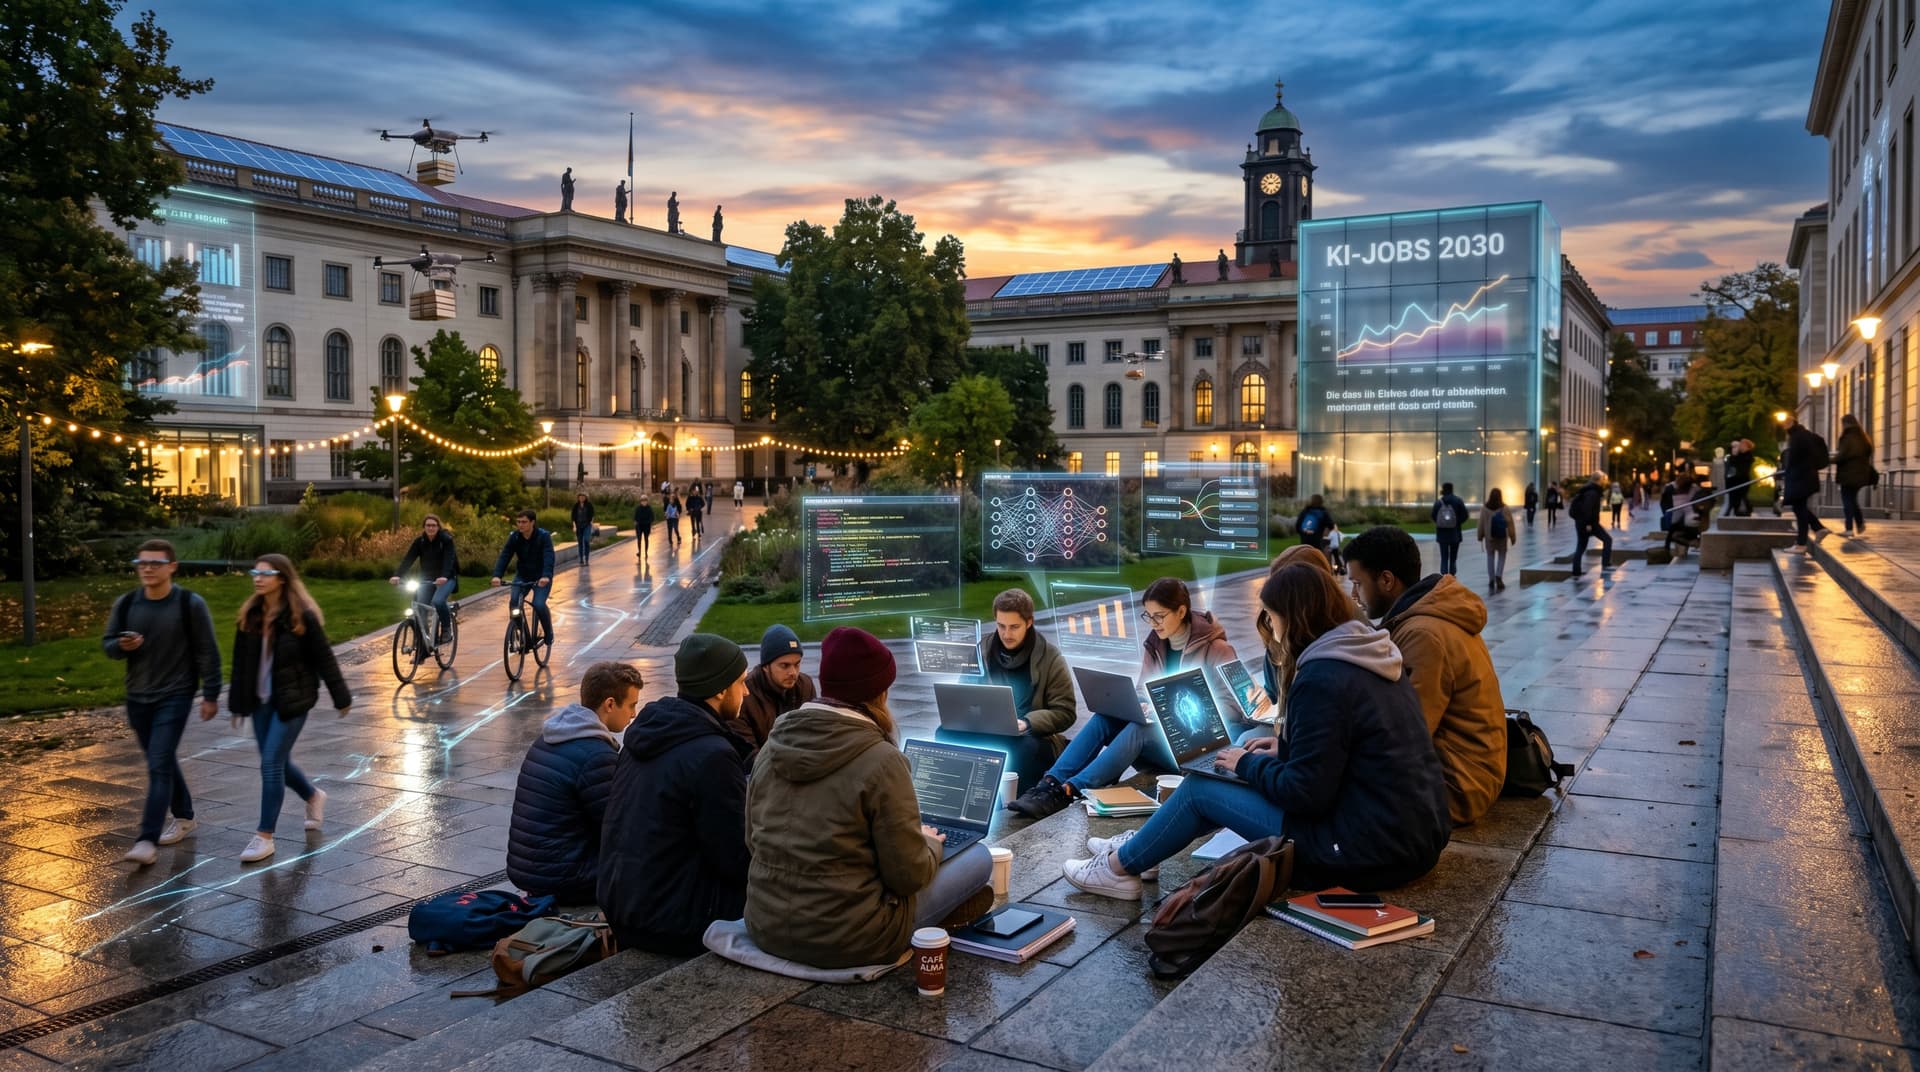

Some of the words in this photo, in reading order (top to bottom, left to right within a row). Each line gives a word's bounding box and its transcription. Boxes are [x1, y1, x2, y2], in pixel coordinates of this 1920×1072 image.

[1327, 238, 1431, 267] KI-JOBS
[1438, 232, 1505, 259] 2030
[1326, 391, 1340, 399] Die
[1431, 387, 1445, 396] für
[921, 953, 944, 964] CAFÉ
[920, 964, 944, 972] ALMA
